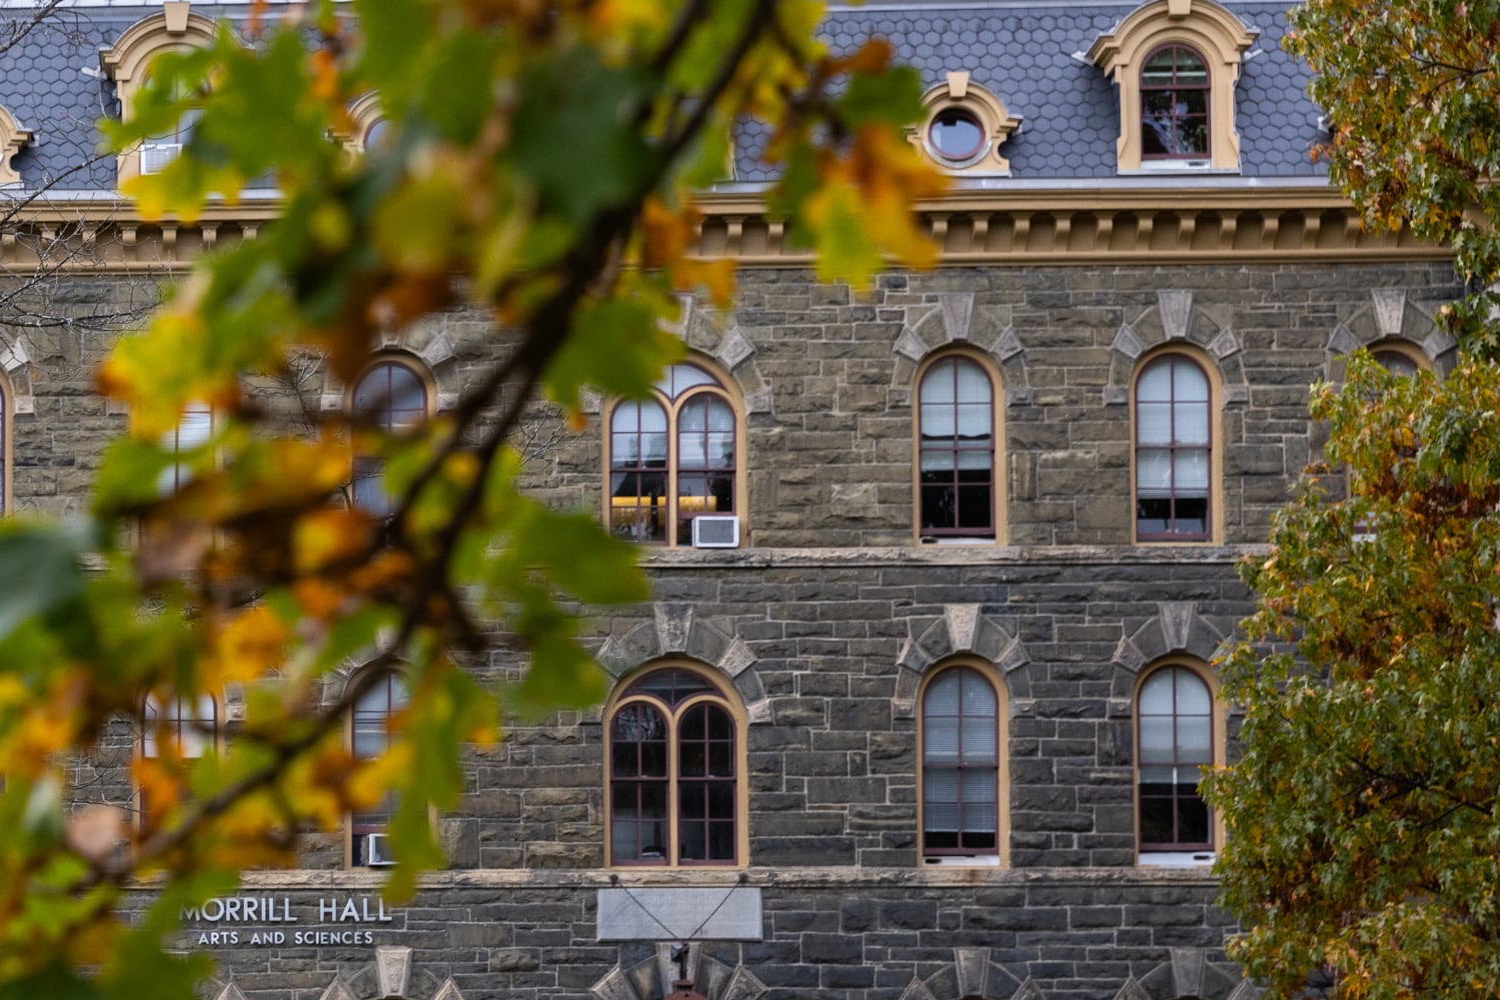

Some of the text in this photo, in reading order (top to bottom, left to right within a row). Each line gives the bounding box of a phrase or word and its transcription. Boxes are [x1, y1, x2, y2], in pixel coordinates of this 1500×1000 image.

[180, 898, 393, 921] MORRILL HALL
[198, 931, 373, 945] ARTS AND SCIENCES
